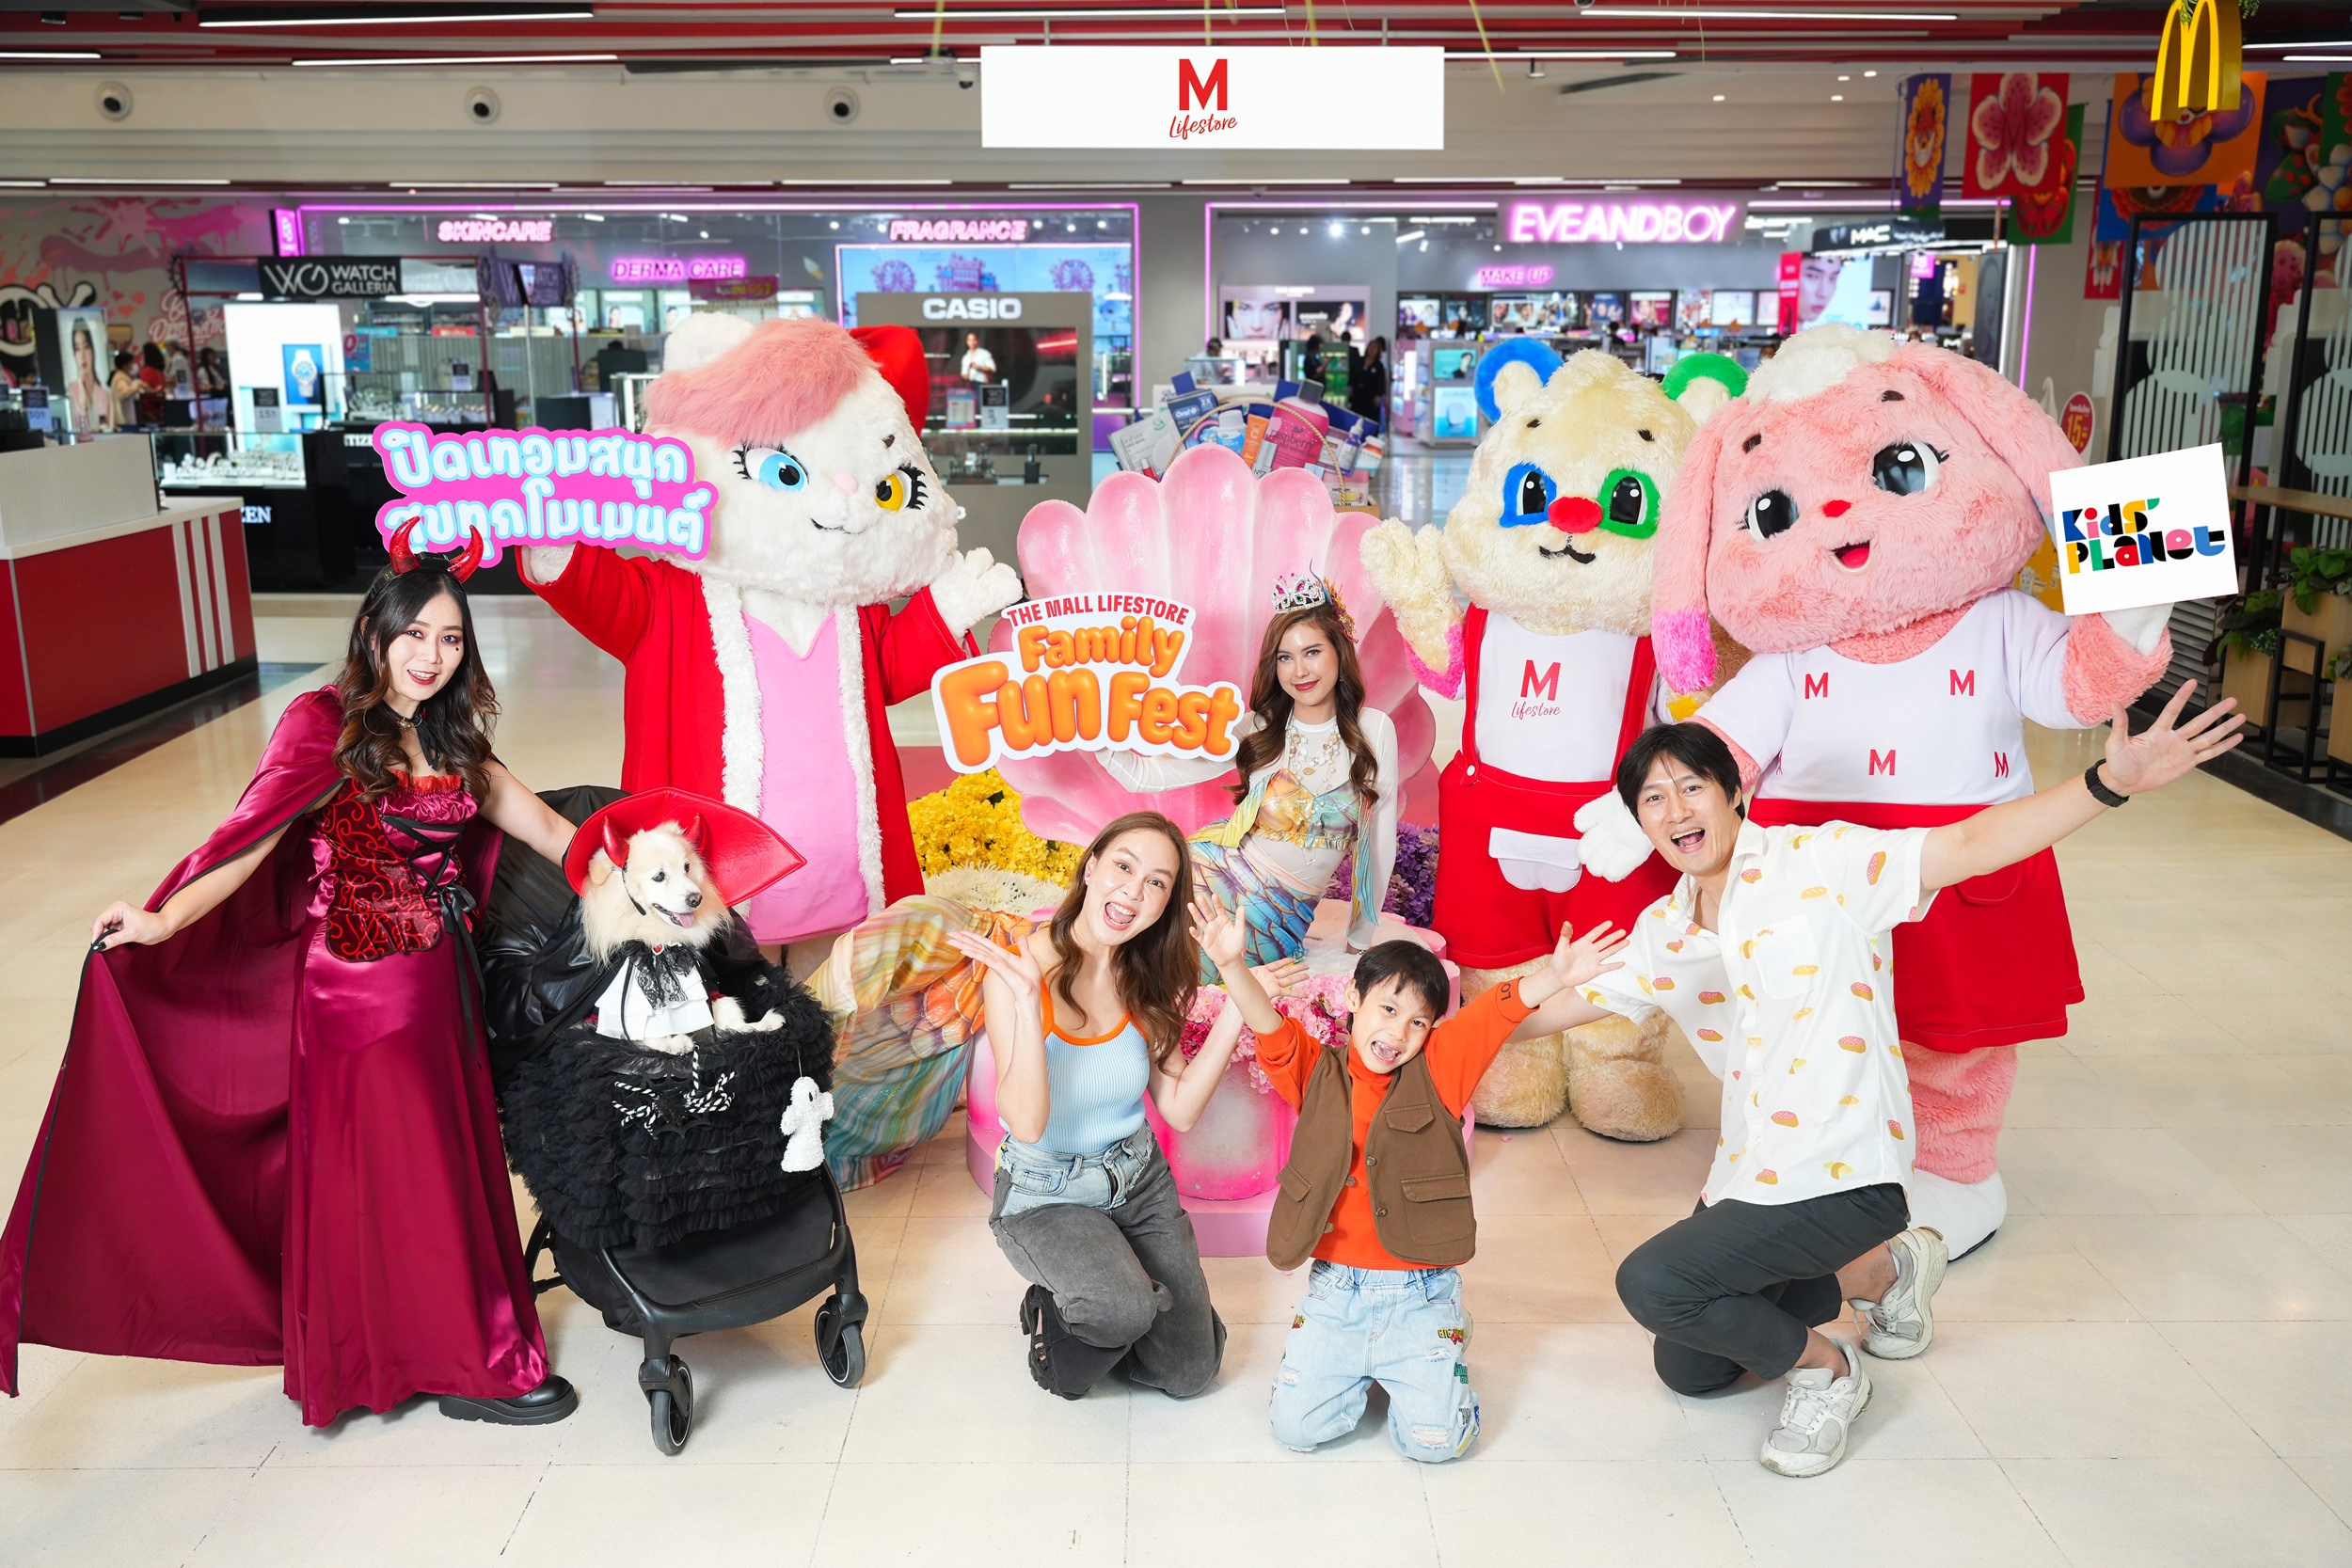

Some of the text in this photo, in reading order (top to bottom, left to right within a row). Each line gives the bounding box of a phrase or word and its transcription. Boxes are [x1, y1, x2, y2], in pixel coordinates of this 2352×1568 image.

[1179, 58, 1228, 111] M
[1168, 113, 1238, 140] Lifestore
[437, 220, 553, 242] SKINCARE
[889, 219, 1027, 241] FRAGRANCE
[1512, 204, 1738, 243] EVEANDBOY
[331, 264, 397, 282] WATCH
[612, 260, 746, 279] DERMA CARE
[1479, 267, 1526, 286] MAKE
[332, 281, 397, 294] GALLERIA
[923, 297, 1022, 320] CASIO
[1270, 429, 1315, 451] raspberry
[380, 428, 688, 499] ปิดเทอมสนุก
[1007, 594, 1189, 627] THE MALL LIFESTORE
[1017, 615, 1185, 677] Family
[1520, 659, 1561, 701] M
[1804, 673, 1828, 699] M
[1949, 669, 1974, 696] M
[939, 660, 1240, 767] Fun Fest
[1511, 701, 1562, 721] Lifestore
[1868, 749, 1897, 776] M
[1994, 751, 2010, 779] M
